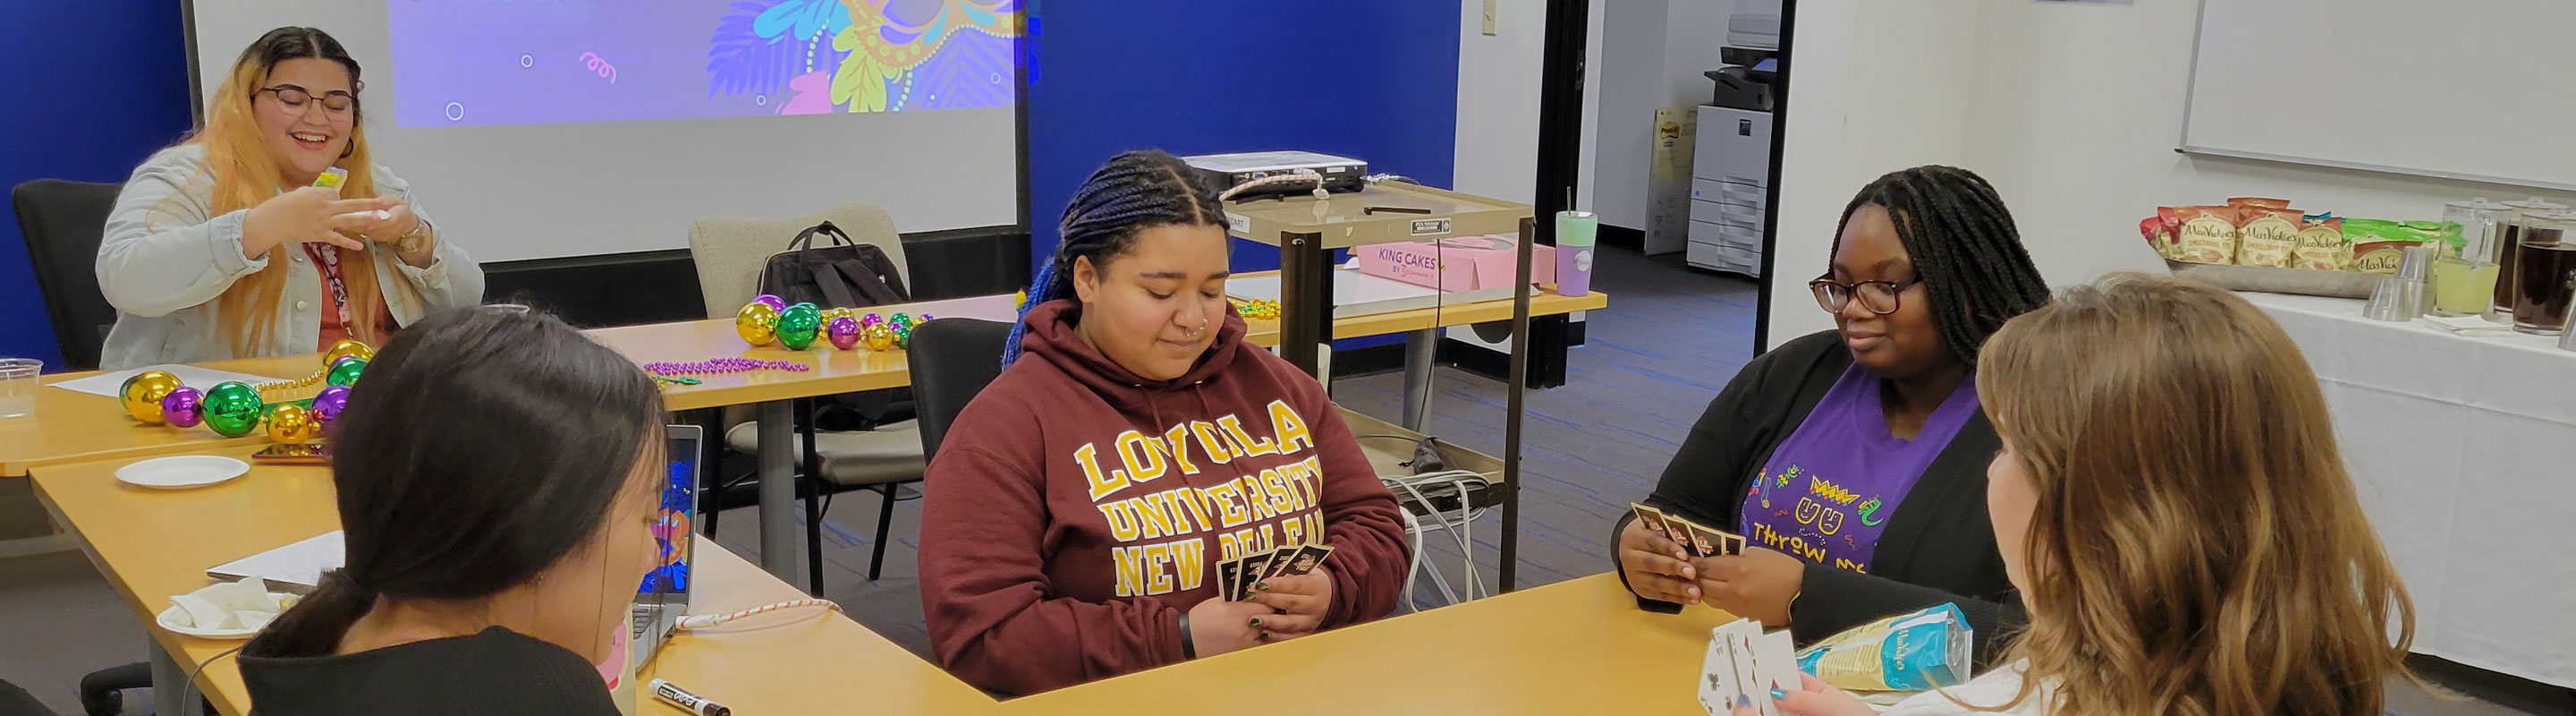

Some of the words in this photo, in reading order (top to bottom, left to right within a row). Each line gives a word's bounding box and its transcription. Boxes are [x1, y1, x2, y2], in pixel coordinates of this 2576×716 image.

[1378, 247, 1402, 263] KING
[1404, 253, 1436, 270] CAKES
[2243, 226, 2267, 239] Miss
[1073, 399, 1315, 503] LOYOLA
[1097, 454, 1323, 542] UNIVERSITY
[1112, 538, 1205, 597] NEW
